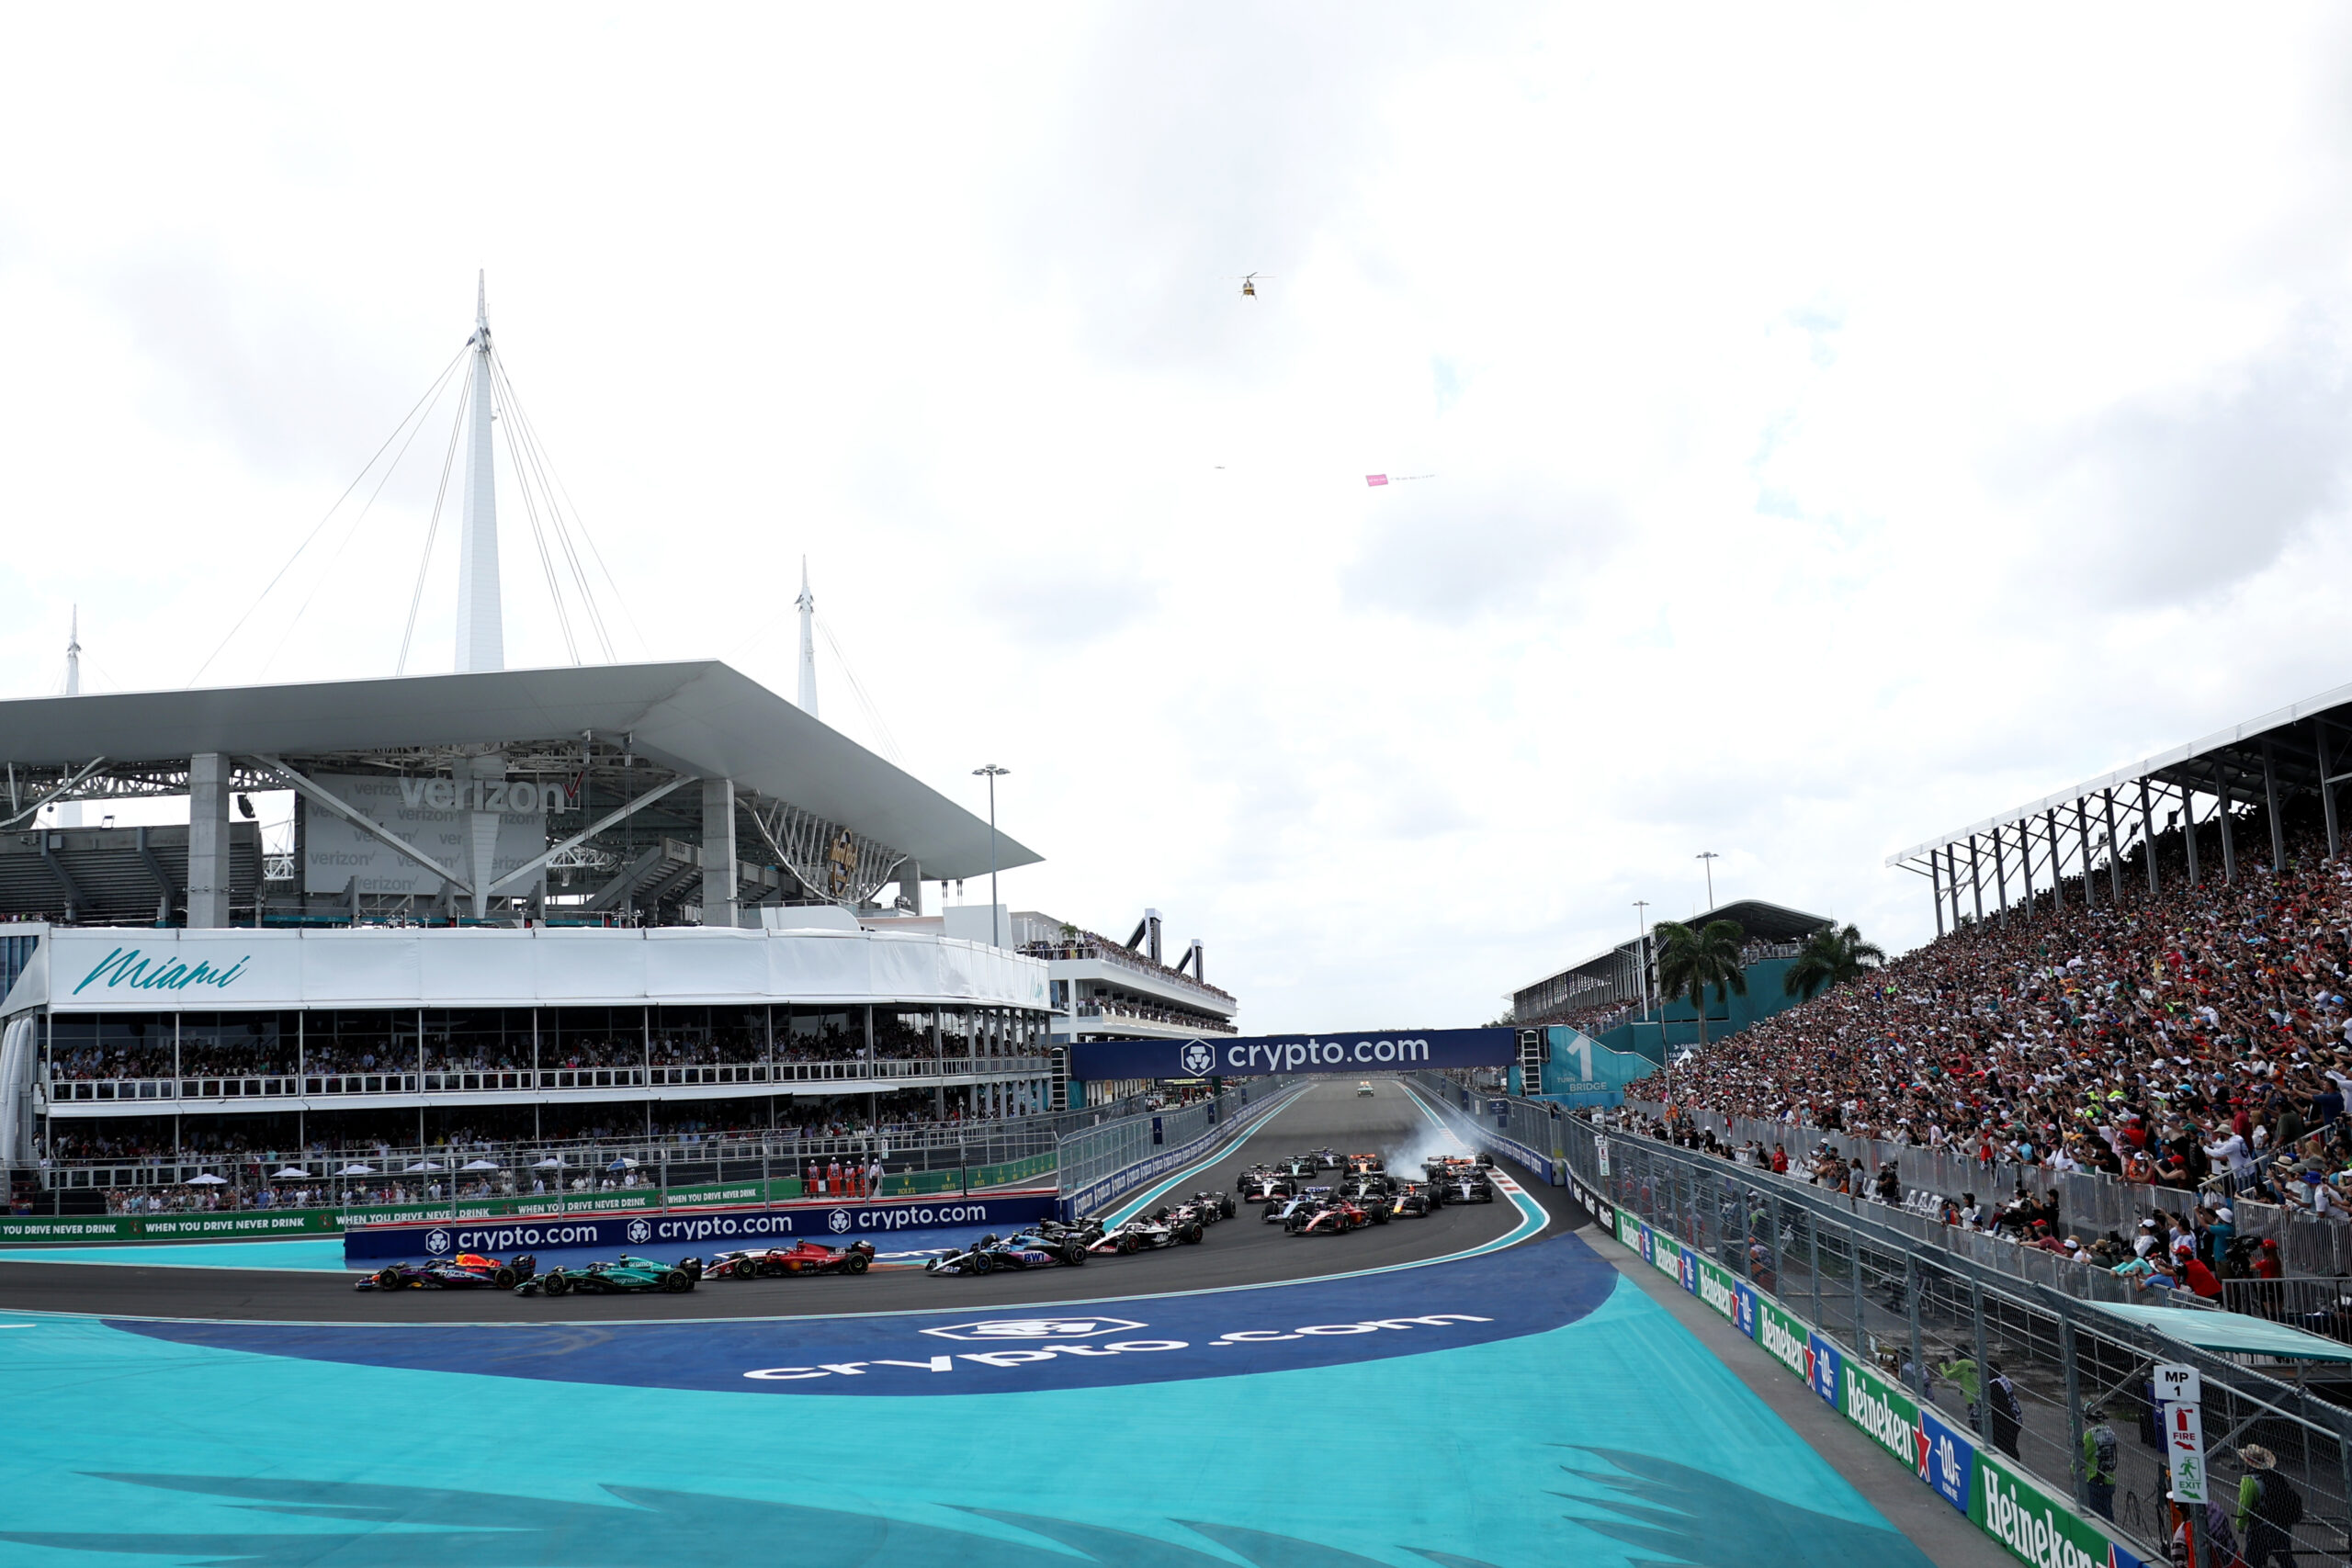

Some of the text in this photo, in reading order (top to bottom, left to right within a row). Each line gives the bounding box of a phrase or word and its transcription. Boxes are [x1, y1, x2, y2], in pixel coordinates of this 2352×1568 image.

[355, 782, 401, 795] verizo
[398, 773, 564, 814] verizon
[310, 852, 368, 865] verizon
[72, 947, 251, 996] Miami
[1227, 1038, 1429, 1071] crypto.com
[1566, 1034, 1593, 1082] 1
[1569, 1082, 1607, 1091] BRIDGE
[667, 1189, 756, 1204] WHEN YOU DRIVE NEVER DRINK
[517, 1204, 545, 1214] WHEN
[568, 1201, 593, 1212] DRIVE
[594, 1200, 619, 1209] NEVER
[621, 1197, 646, 1207] DRINK
[335, 1215, 367, 1225] WHEN
[369, 1213, 391, 1224] YOU
[393, 1212, 423, 1222] DRIVE
[458, 1208, 490, 1218] DRINK
[858, 1205, 986, 1230] crypto.com
[3, 1224, 117, 1235] YOU DRIVE NEVER DRINK
[145, 1217, 305, 1234] WHEN YOU DRIVE NEVER DRINK
[659, 1216, 792, 1241] crypto.com
[458, 1225, 597, 1250] crypto.com
[1024, 1252, 1046, 1263] BWT
[1699, 1263, 1732, 1317] Heineken
[742, 1314, 1495, 1380] crypto.com
[1760, 1303, 1804, 1376] Heineken
[2165, 1371, 2189, 1383] MP
[2174, 1385, 2181, 1397] 1
[1846, 1367, 1914, 1465] Heineken
[2173, 1432, 2196, 1440] FIRE
[2178, 1481, 2202, 1490] EXIT
